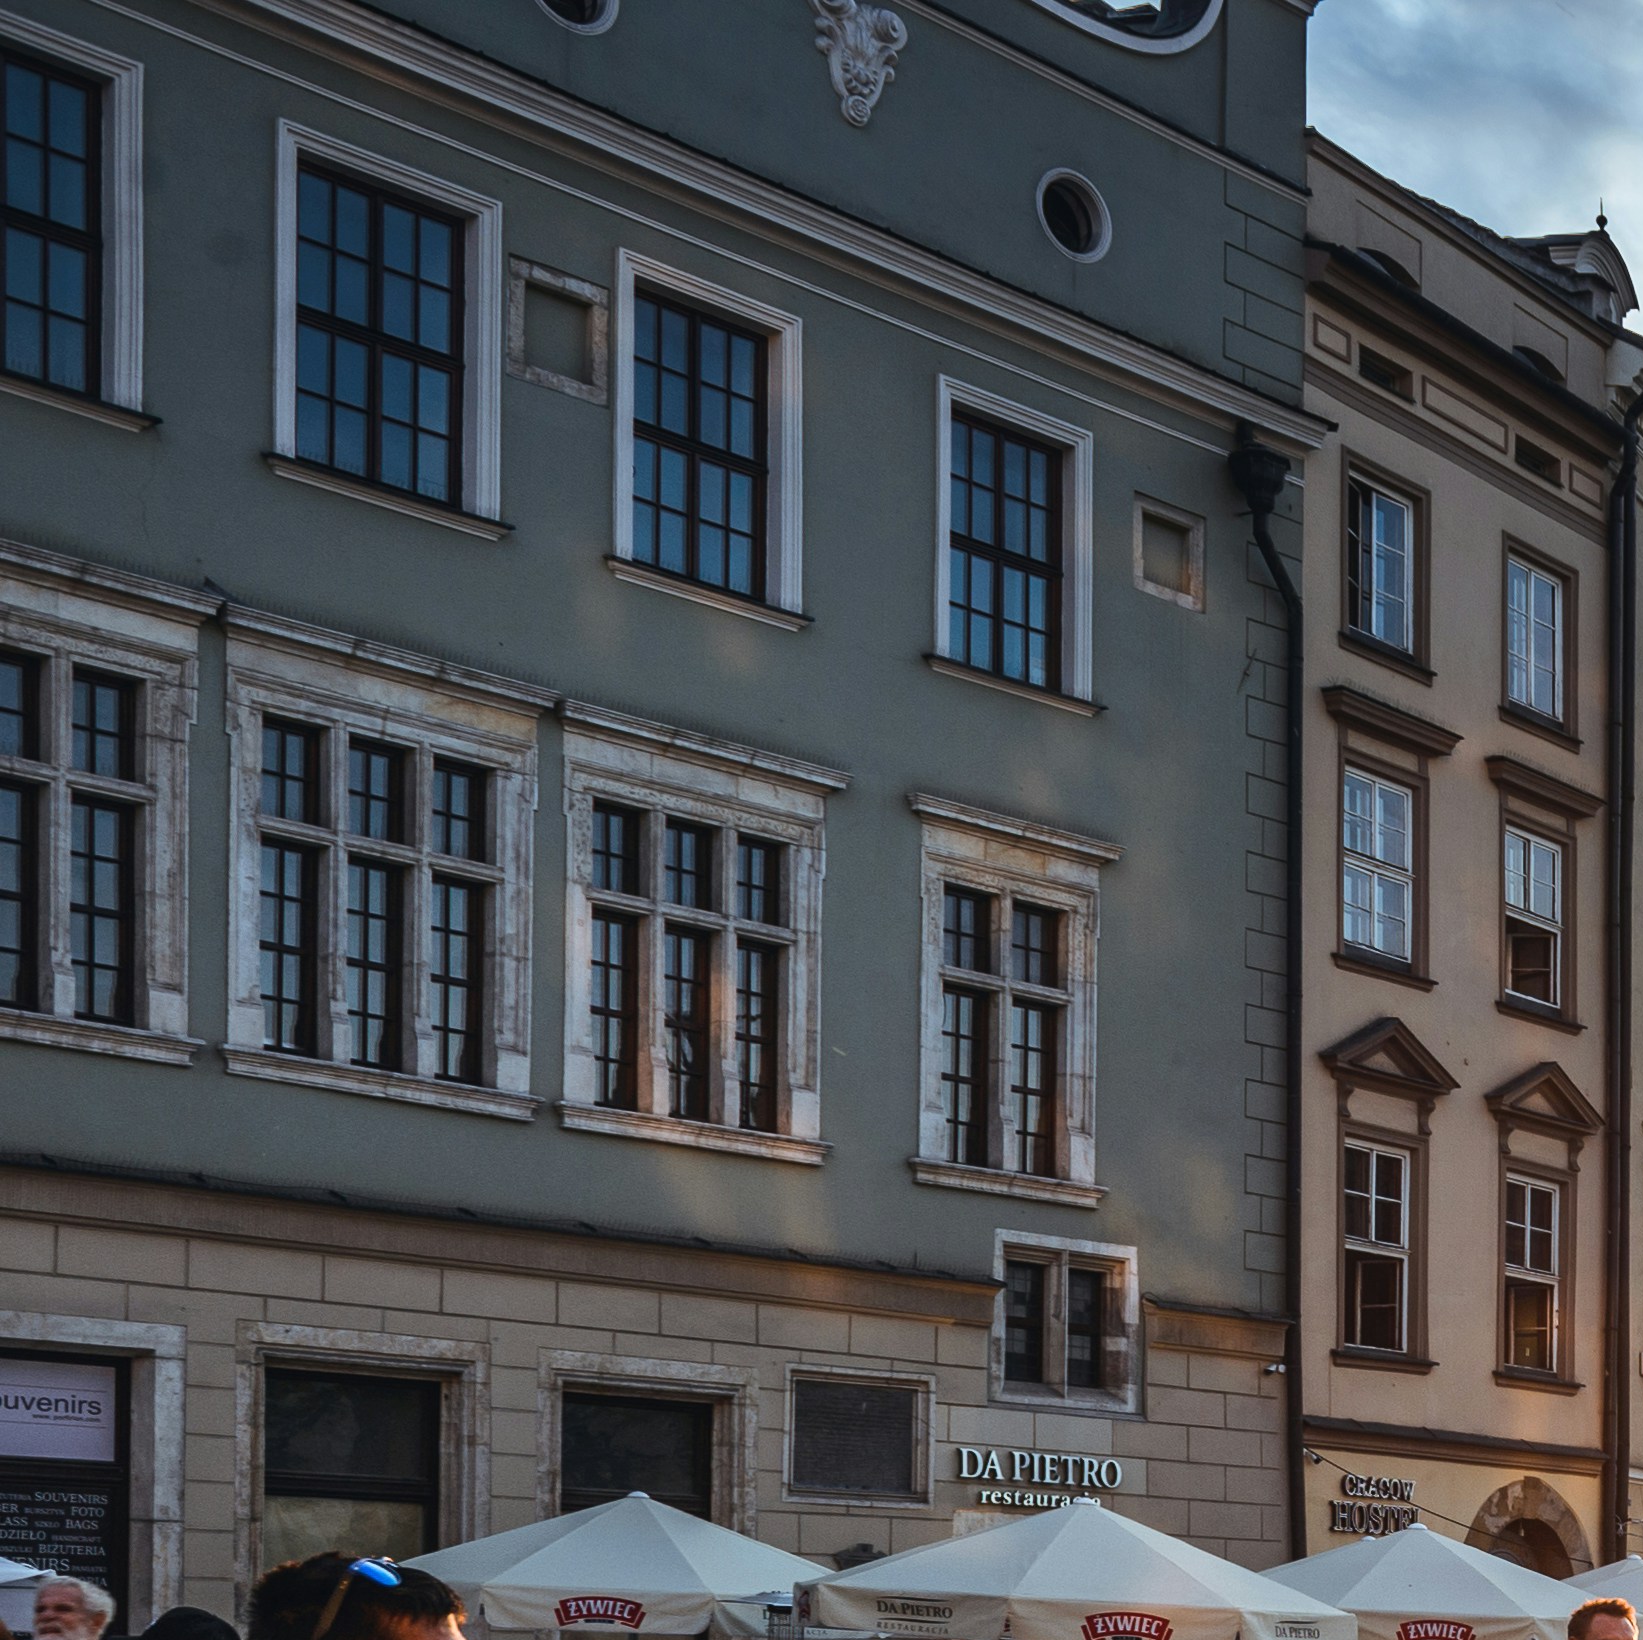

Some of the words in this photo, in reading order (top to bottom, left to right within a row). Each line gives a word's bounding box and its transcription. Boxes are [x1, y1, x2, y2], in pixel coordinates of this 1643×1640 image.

[0, 1394, 102, 1416] uvenirs
[959, 1447, 1004, 1480] DA
[1011, 1451, 1122, 1488] PIETRO
[1343, 1474, 1416, 1501] CRACOW
[35, 1491, 108, 1505] SOUVENIRS
[0, 1503, 19, 1513] ER
[71, 1506, 105, 1517] FOTO
[65, 1519, 99, 1530] BAGS
[39, 1543, 106, 1556] BIŻUTERIA
[567, 1599, 635, 1619] ŻYWIEC
[876, 1600, 898, 1614] DA
[902, 1602, 953, 1618] PIETRO
[876, 1621, 949, 1635] RESTAURACJA
[1094, 1613, 1164, 1636] ŻYWIEC
[1275, 1625, 1287, 1638] DA
[1289, 1626, 1321, 1639] PIETRO
